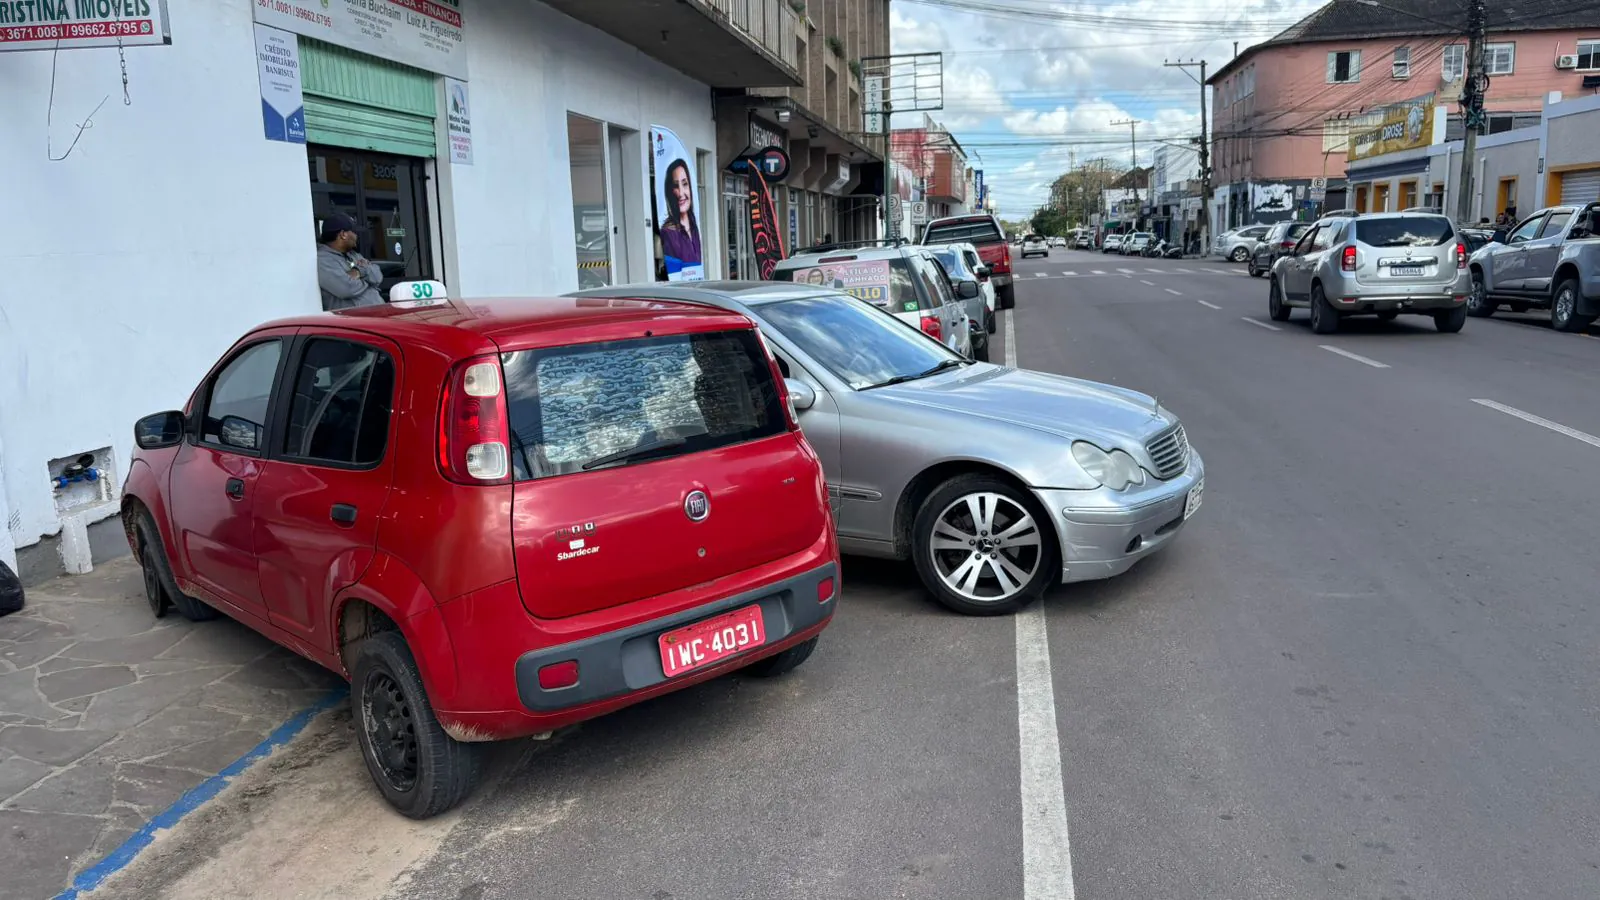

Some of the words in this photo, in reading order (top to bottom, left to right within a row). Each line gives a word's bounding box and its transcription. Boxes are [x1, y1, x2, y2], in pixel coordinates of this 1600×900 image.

[422, 1, 461, 25] FINANCIA
[406, 12, 421, 28] Luiz
[431, 21, 462, 42] Figueiredo
[264, 43, 291, 58] CRÉDITO
[265, 64, 295, 78] BANRISUL
[1382, 121, 1404, 140] DROSE
[411, 283, 433, 298] 30
[690, 498, 705, 514] FIAT
[557, 546, 600, 561] Sbardecar
